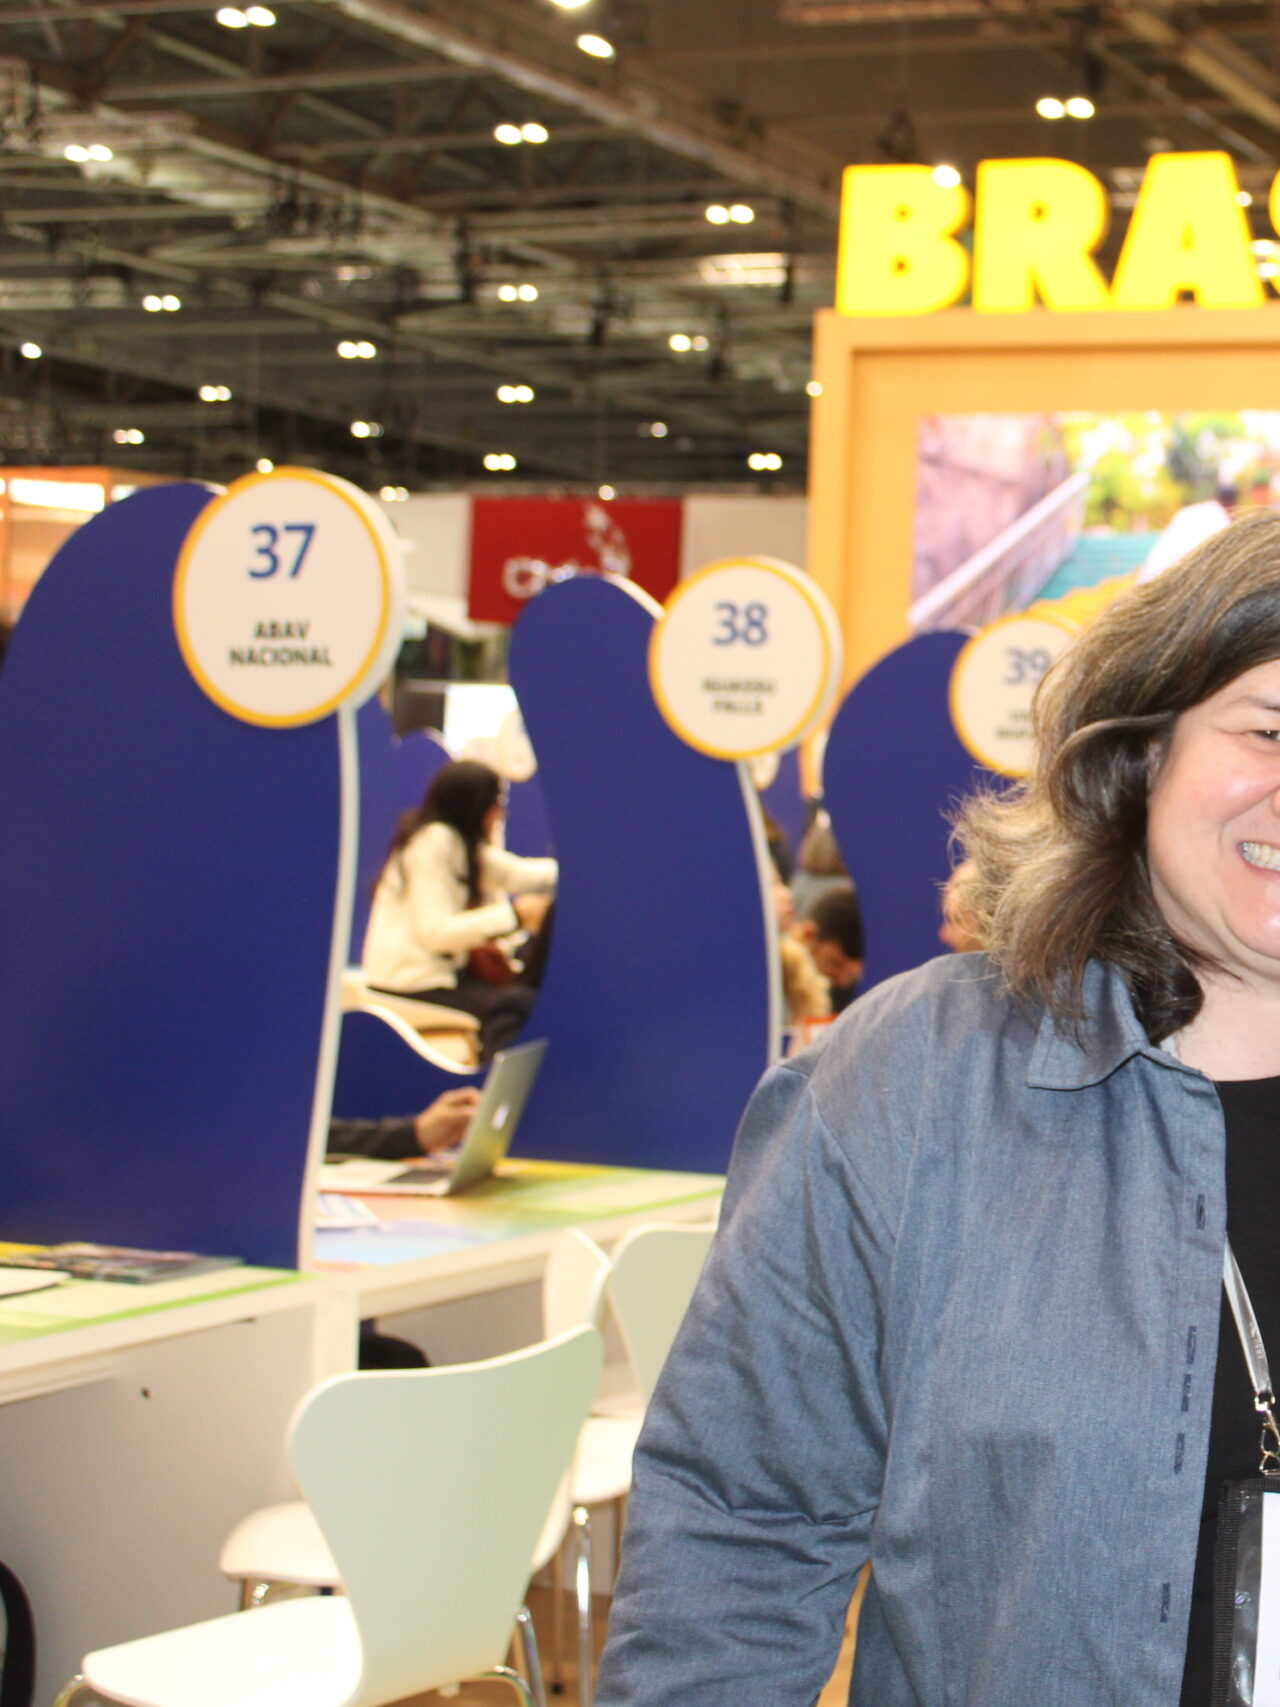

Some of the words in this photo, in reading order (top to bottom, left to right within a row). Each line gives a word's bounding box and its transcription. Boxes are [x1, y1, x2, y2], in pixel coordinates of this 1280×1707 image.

[248, 523, 316, 579] 37
[254, 621, 310, 640] ABAV
[712, 602, 768, 646] 38
[229, 646, 332, 667] NACIONAL
